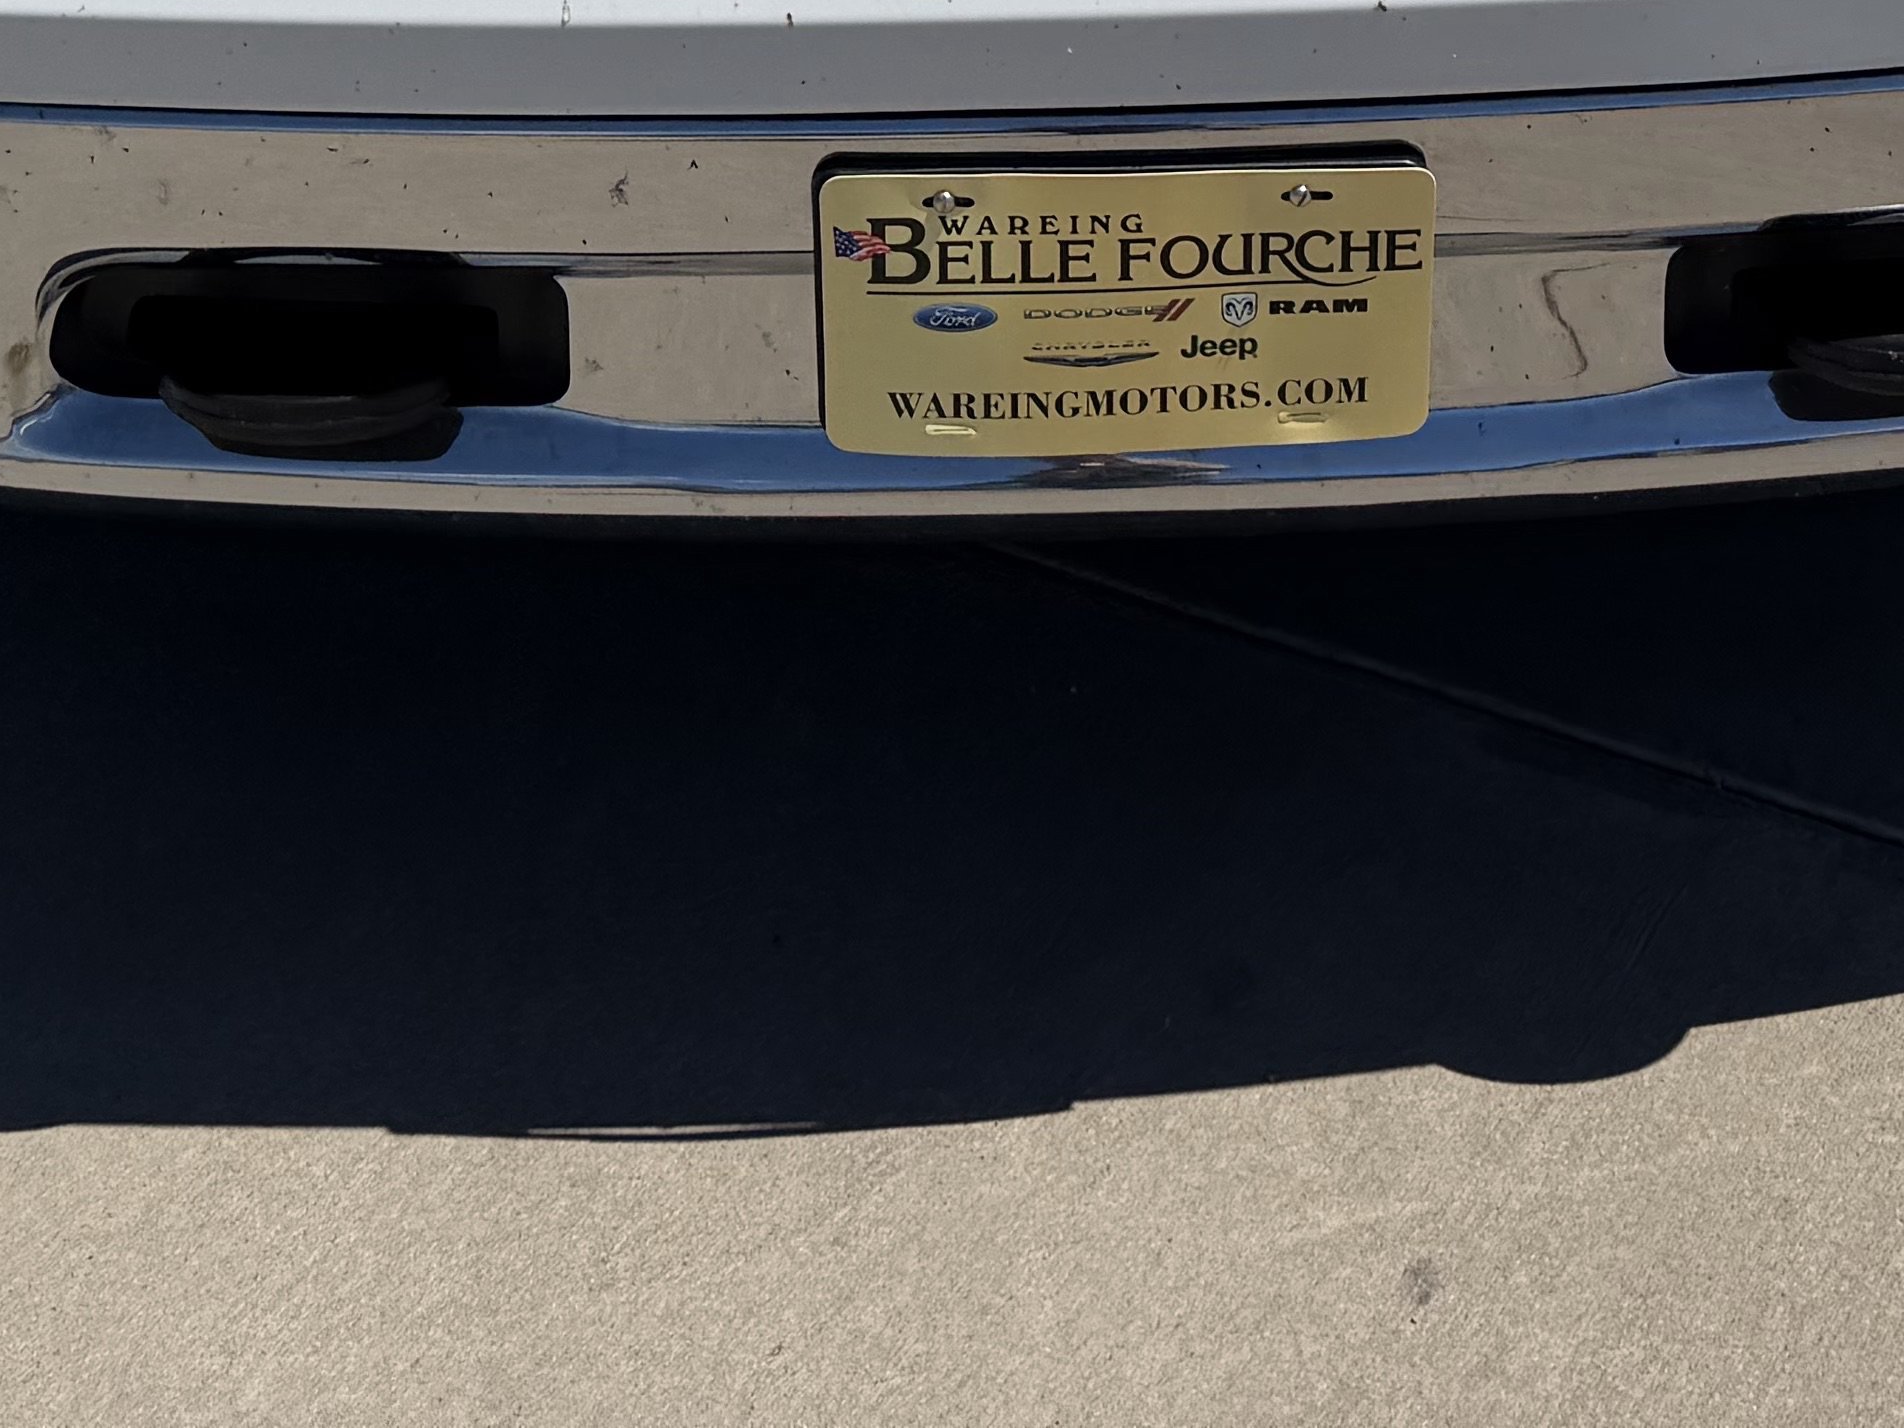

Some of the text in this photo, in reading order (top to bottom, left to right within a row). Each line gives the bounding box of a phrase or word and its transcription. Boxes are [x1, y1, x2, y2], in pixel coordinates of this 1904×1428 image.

[937, 213, 1145, 237] WAREING
[866, 217, 1423, 287] BELLE FOURCHE
[1023, 305, 1170, 321] DODGE
[1268, 298, 1369, 315] RAM
[1180, 334, 1259, 361] Jeep
[887, 375, 1370, 421] WAREINGMOTORS.COM
